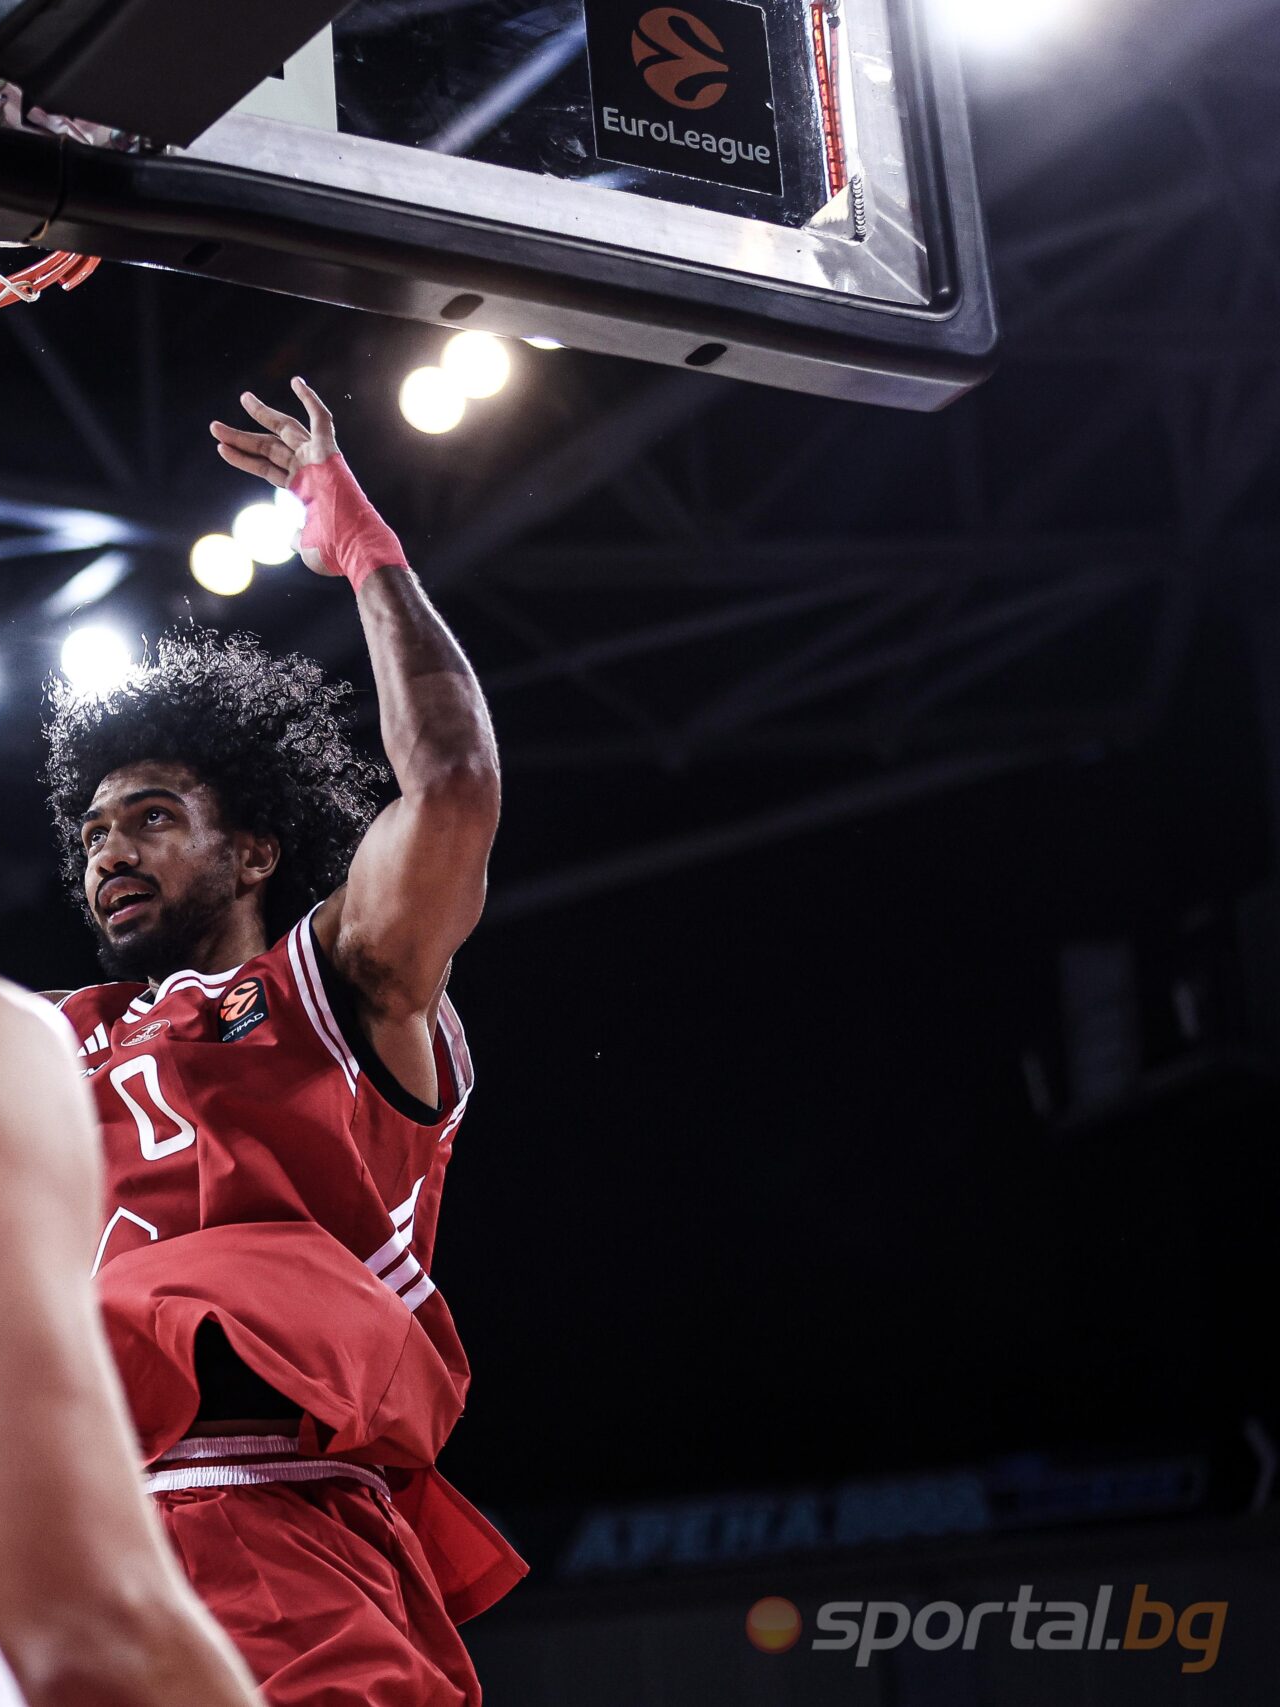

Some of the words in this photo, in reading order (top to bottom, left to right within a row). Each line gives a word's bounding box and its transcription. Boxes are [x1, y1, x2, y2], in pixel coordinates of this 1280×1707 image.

[602, 106, 770, 164] EuroLeague
[222, 1012, 264, 1042] ETIHAD
[109, 1053, 196, 1161] 0
